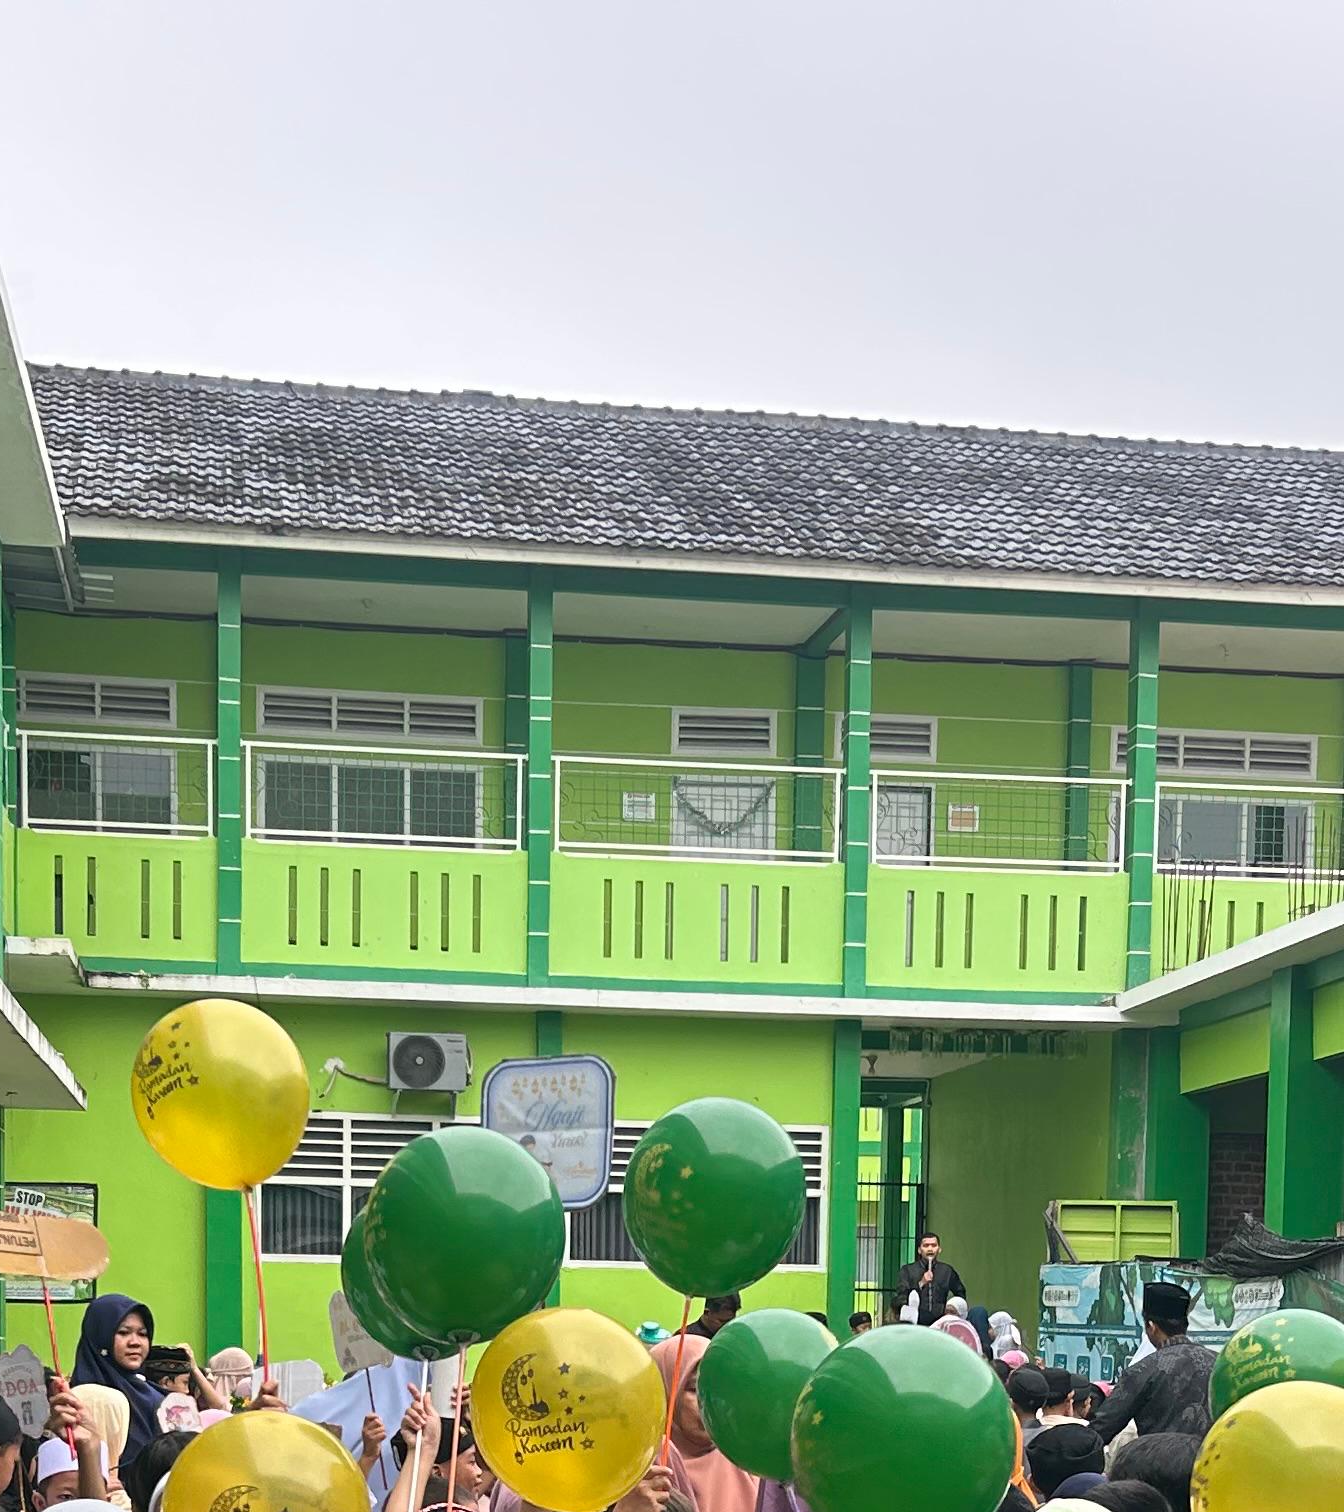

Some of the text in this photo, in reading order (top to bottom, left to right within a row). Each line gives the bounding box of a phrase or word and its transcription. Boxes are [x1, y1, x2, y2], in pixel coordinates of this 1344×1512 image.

[16, 1190, 43, 1207] STOP
[505, 1418, 587, 1438] Ramadan
[519, 1436, 575, 1454] Kareem
